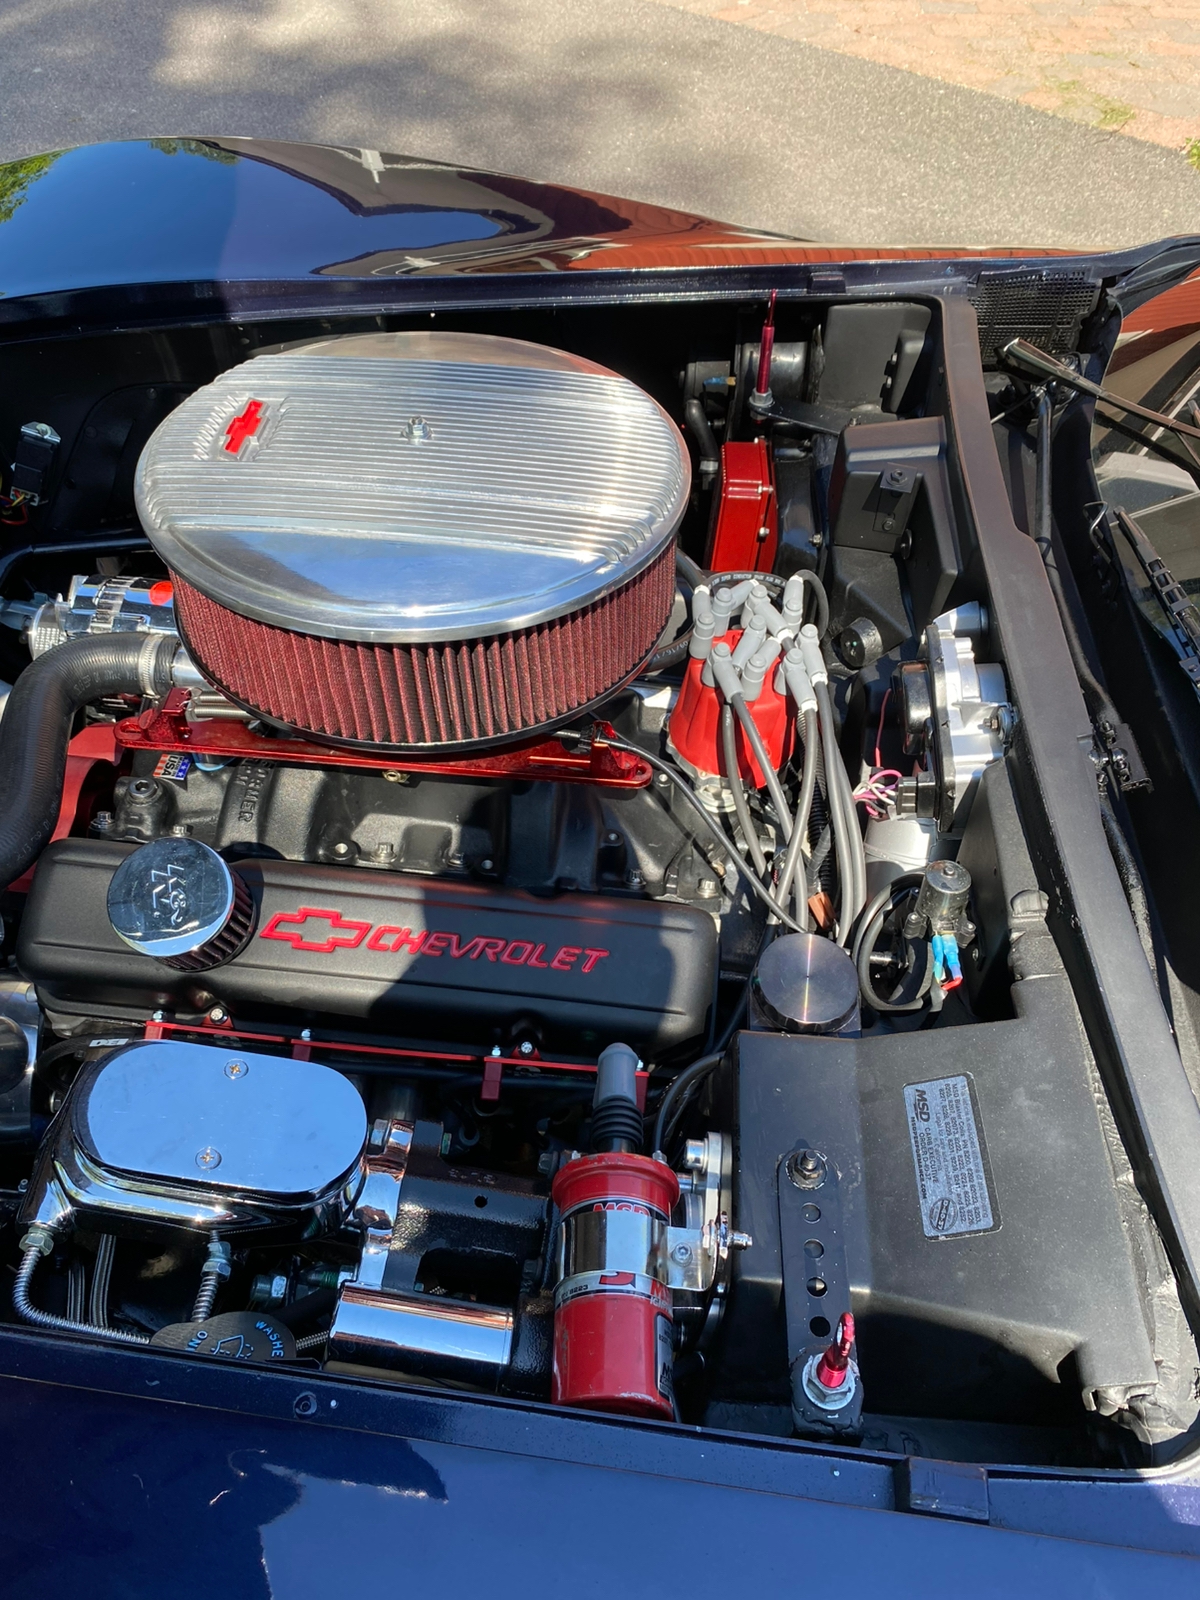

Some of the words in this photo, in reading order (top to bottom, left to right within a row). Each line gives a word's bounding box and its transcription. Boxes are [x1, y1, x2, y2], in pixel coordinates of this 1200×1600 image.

[161, 755, 179, 776] USA
[366, 925, 609, 973] CHEVROLET
[915, 1086, 931, 1123] MSD
[918, 1132, 928, 1156] ORDER
[924, 1126, 933, 1146] CARB
[910, 1115, 927, 1199] MSDPERFORMANCE.COM
[927, 1146, 939, 1184] EXECUTIVE
[255, 1320, 284, 1358] WASHE
